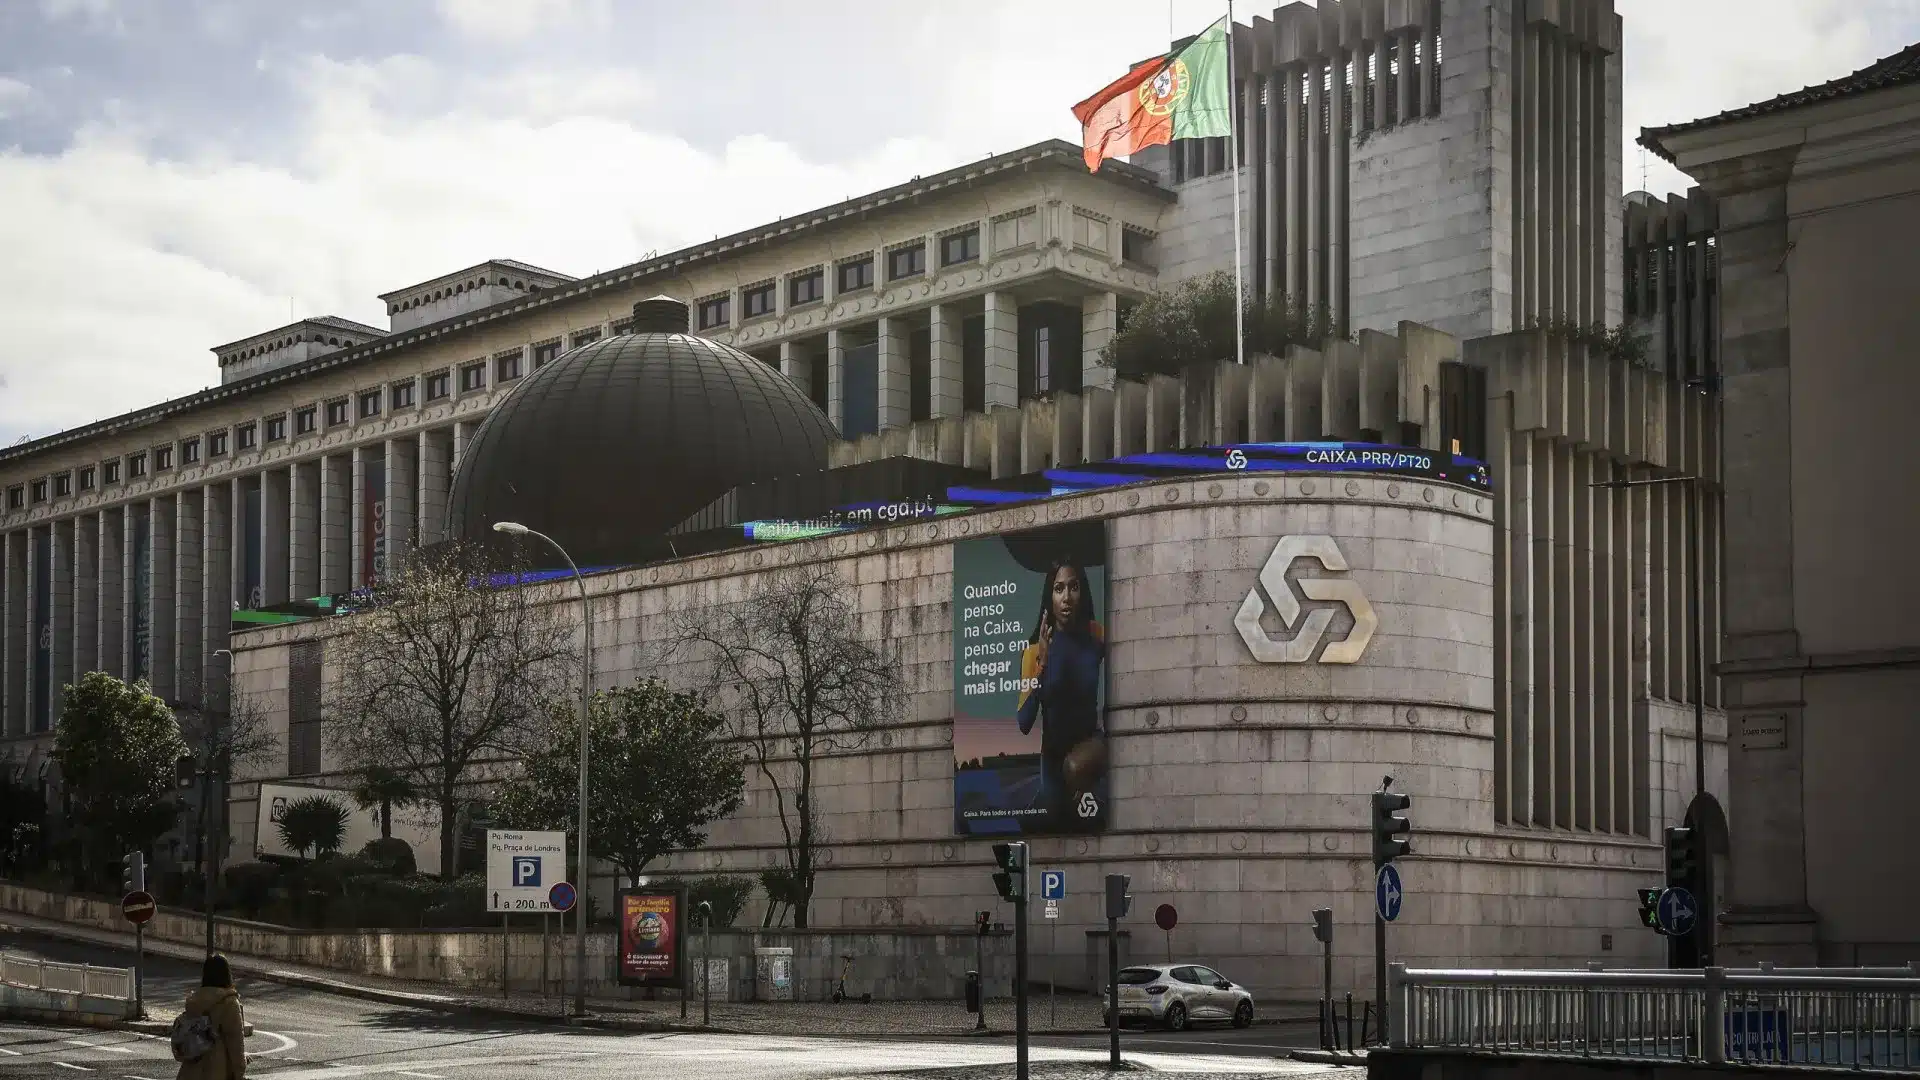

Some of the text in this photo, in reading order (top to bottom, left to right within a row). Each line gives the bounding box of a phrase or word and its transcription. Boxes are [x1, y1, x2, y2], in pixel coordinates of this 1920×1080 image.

[1306, 450, 1431, 470] CAIXA PRR/PT20
[847, 507, 872, 523] em
[878, 494, 934, 521] cgd.pt
[964, 580, 1017, 600] Quando
[964, 603, 1004, 621] penso
[964, 619, 1023, 638] na Caixa,
[964, 639, 1030, 660] penso em
[964, 660, 1011, 676] chegar
[964, 677, 1042, 696] mais longe.
[1012, 809, 1023, 817] para
[504, 844, 523, 852] Praça
[519, 861, 535, 885] P
[1045, 874, 1059, 897] P
[516, 899, 535, 909] 200
[540, 901, 550, 909] m
